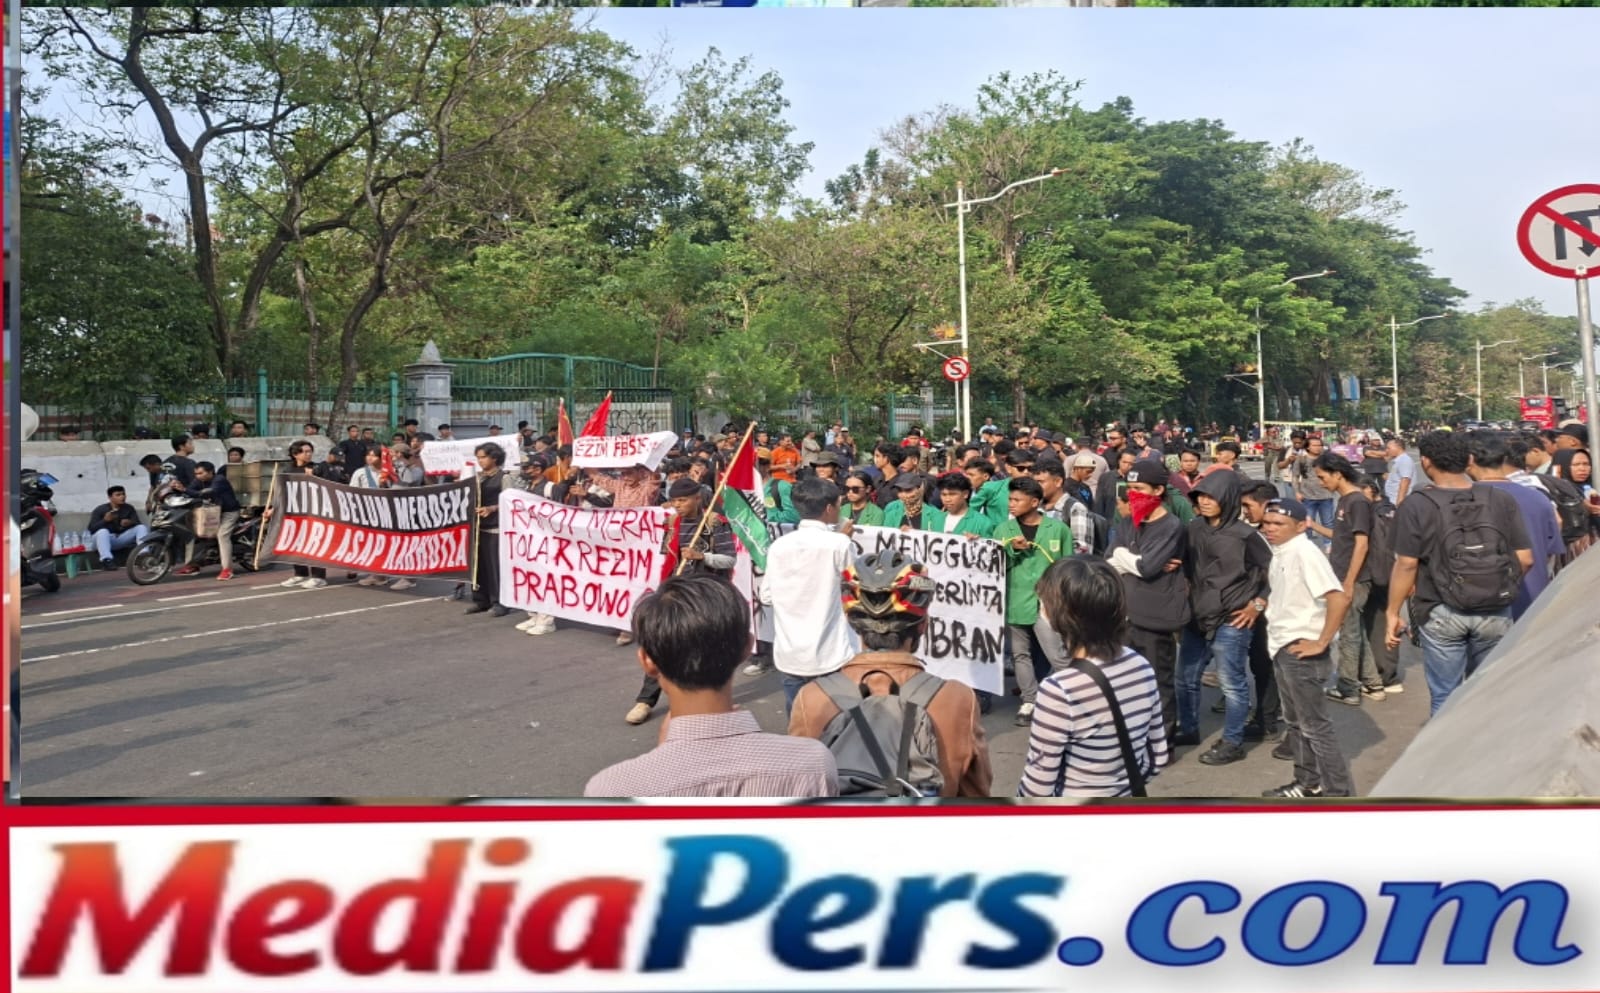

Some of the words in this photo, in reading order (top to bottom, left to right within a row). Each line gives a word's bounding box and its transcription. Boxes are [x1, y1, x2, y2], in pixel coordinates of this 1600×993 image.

[286, 481, 334, 518] KITA
[335, 489, 393, 529] BELUM
[511, 499, 584, 535] RAPOT
[276, 518, 334, 557] DARI
[330, 528, 386, 567] ASAP
[504, 531, 574, 571] TOLAK
[576, 541, 653, 582] REZIM
[512, 566, 630, 618] PRABOWO
